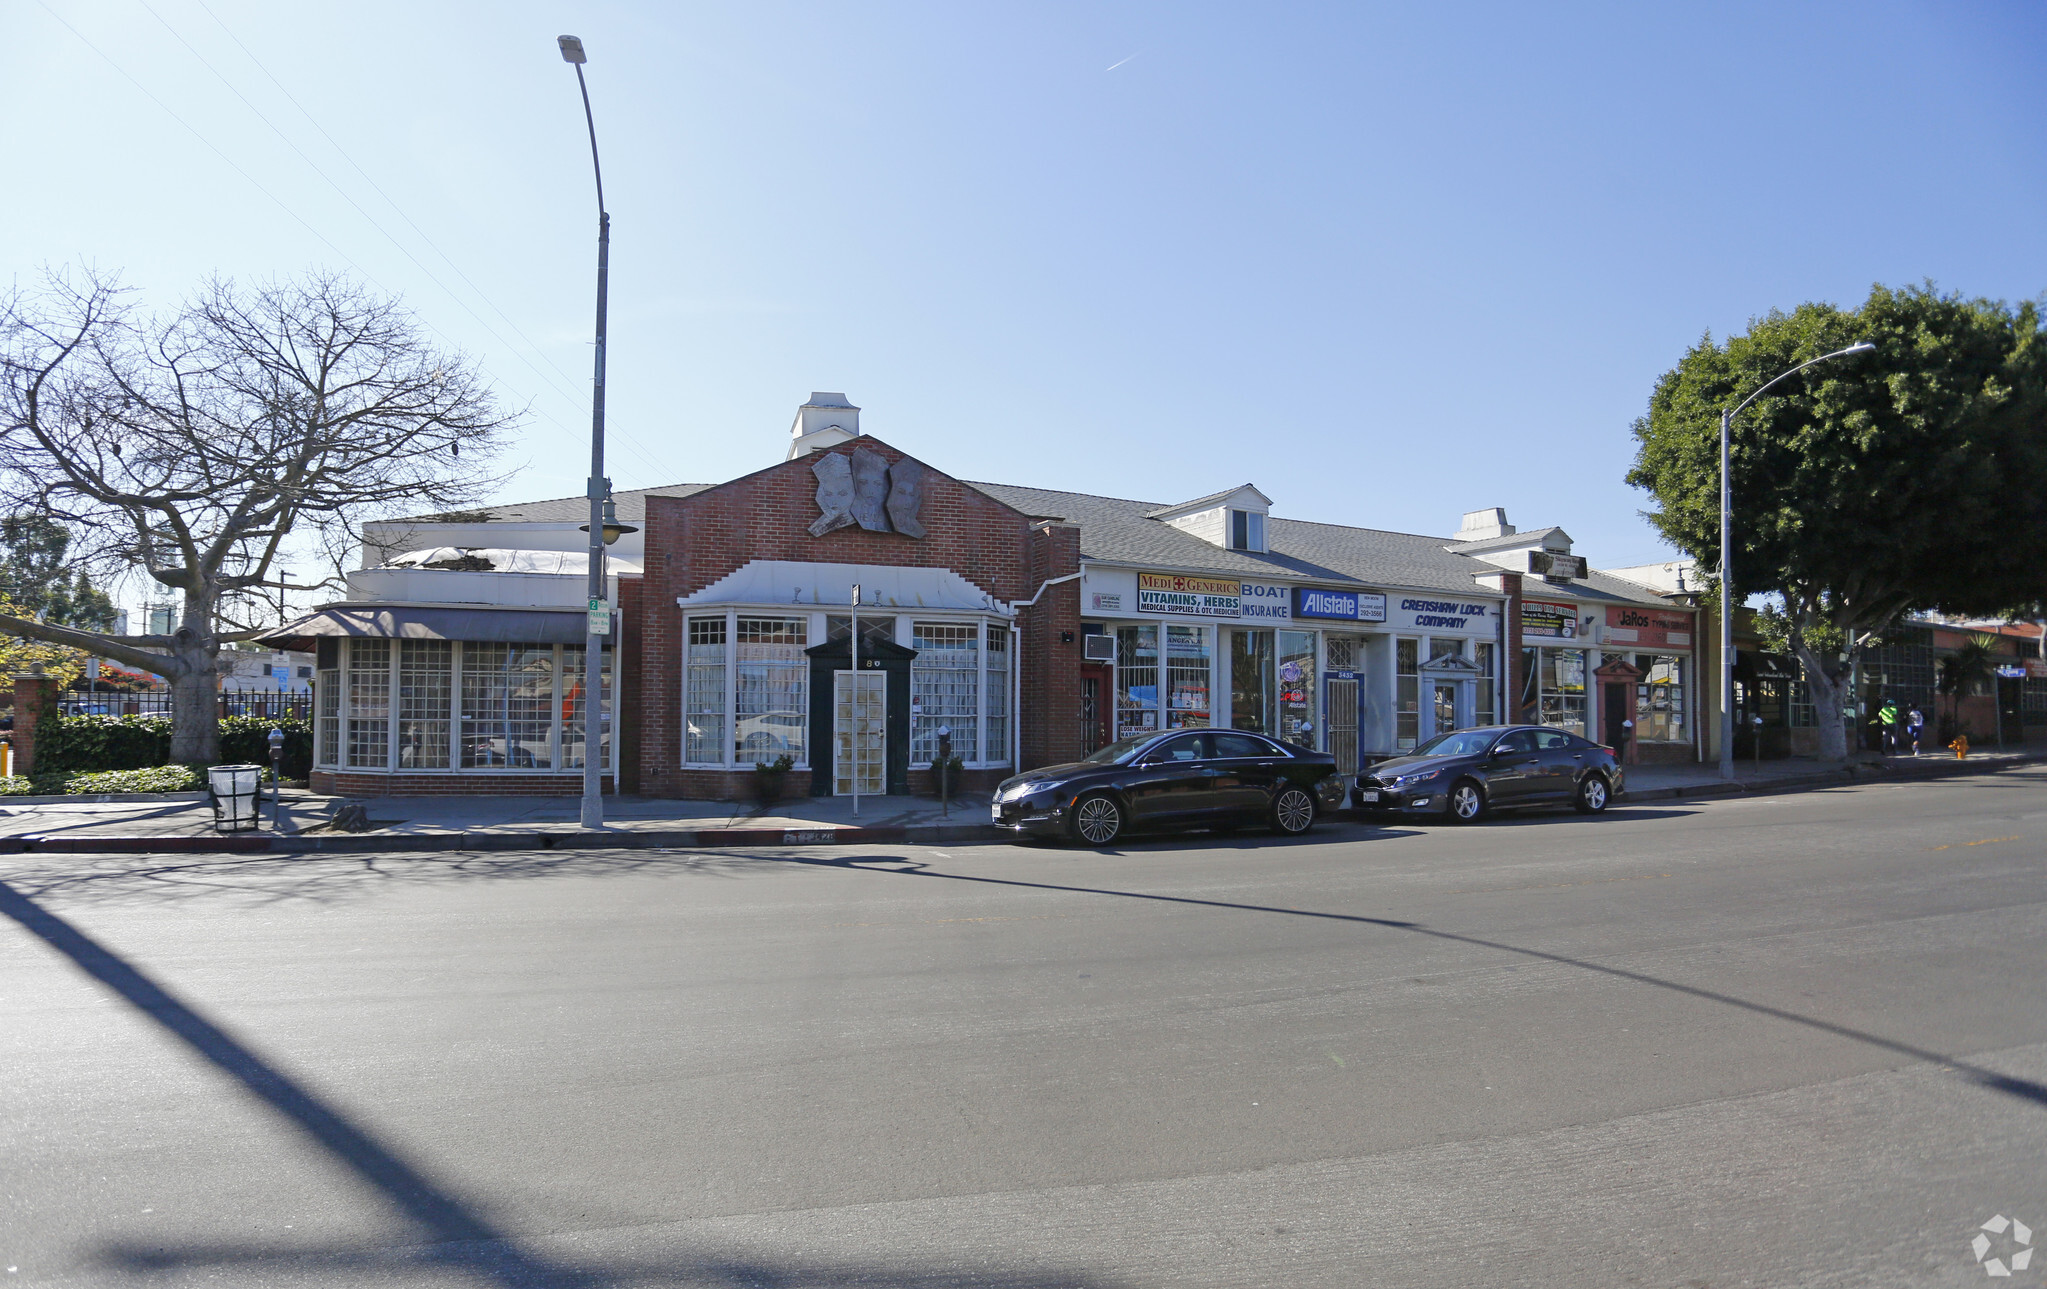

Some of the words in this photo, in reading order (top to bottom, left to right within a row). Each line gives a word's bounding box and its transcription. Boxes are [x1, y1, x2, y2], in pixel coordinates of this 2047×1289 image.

[1141, 575, 1171, 589] MEDI
[1187, 578, 1239, 594] GENERICS
[1242, 584, 1288, 598] BOAT
[1141, 591, 1201, 607] VITAMINS,
[1204, 596, 1239, 609] HERBS
[1303, 593, 1355, 615] Allstate
[1401, 599, 1460, 614] CRENSHAW
[1459, 603, 1486, 616] LOCK
[1141, 603, 1166, 612] MEDICAL
[1167, 604, 1194, 613] SUPPLIES
[1213, 608, 1239, 616] MEDICINE
[1242, 604, 1288, 618] INSURANCE
[1415, 614, 1468, 629] COMPANY
[1620, 610, 1649, 627] JaRos
